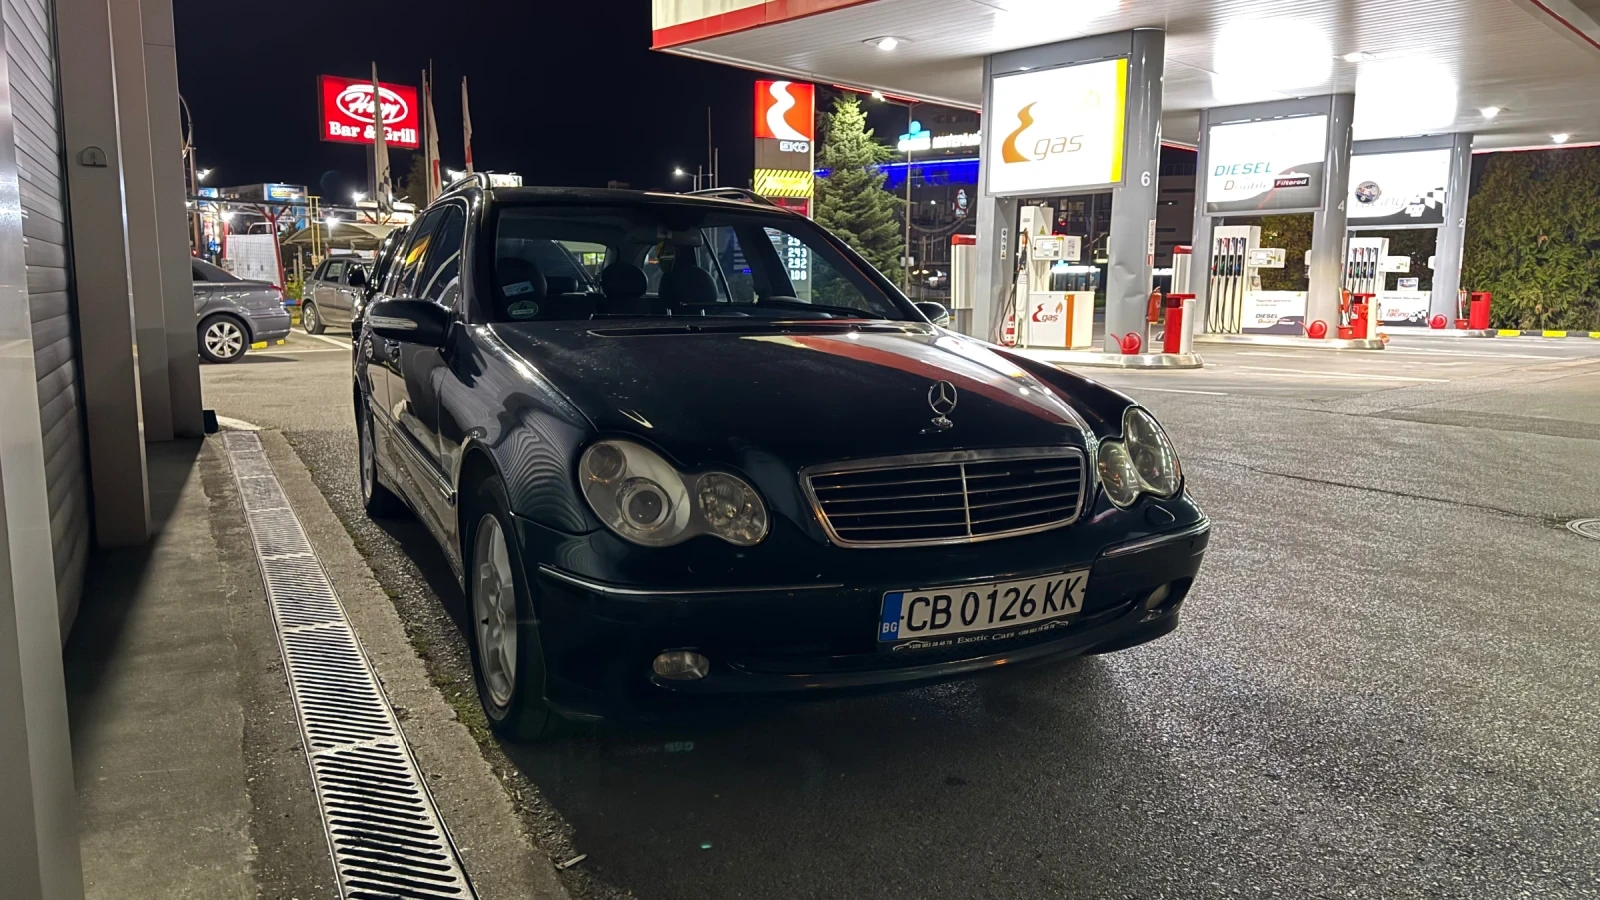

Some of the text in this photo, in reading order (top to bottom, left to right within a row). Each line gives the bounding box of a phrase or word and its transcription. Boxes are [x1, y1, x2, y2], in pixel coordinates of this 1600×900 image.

[328, 121, 417, 144] Bar & Grill
[779, 140, 809, 153] EKO
[1034, 135, 1084, 161] gas
[1213, 162, 1272, 176] DIESEL
[1140, 170, 1151, 187] 6
[1276, 178, 1307, 187] Filtered
[1337, 199, 1345, 212] 4
[1458, 217, 1465, 228] 2
[1041, 314, 1059, 323] gas
[906, 575, 1083, 632] CB 0126 KK
[882, 621, 898, 633] BG
[957, 634, 989, 644] Exotic
[991, 632, 1015, 641] Cars
